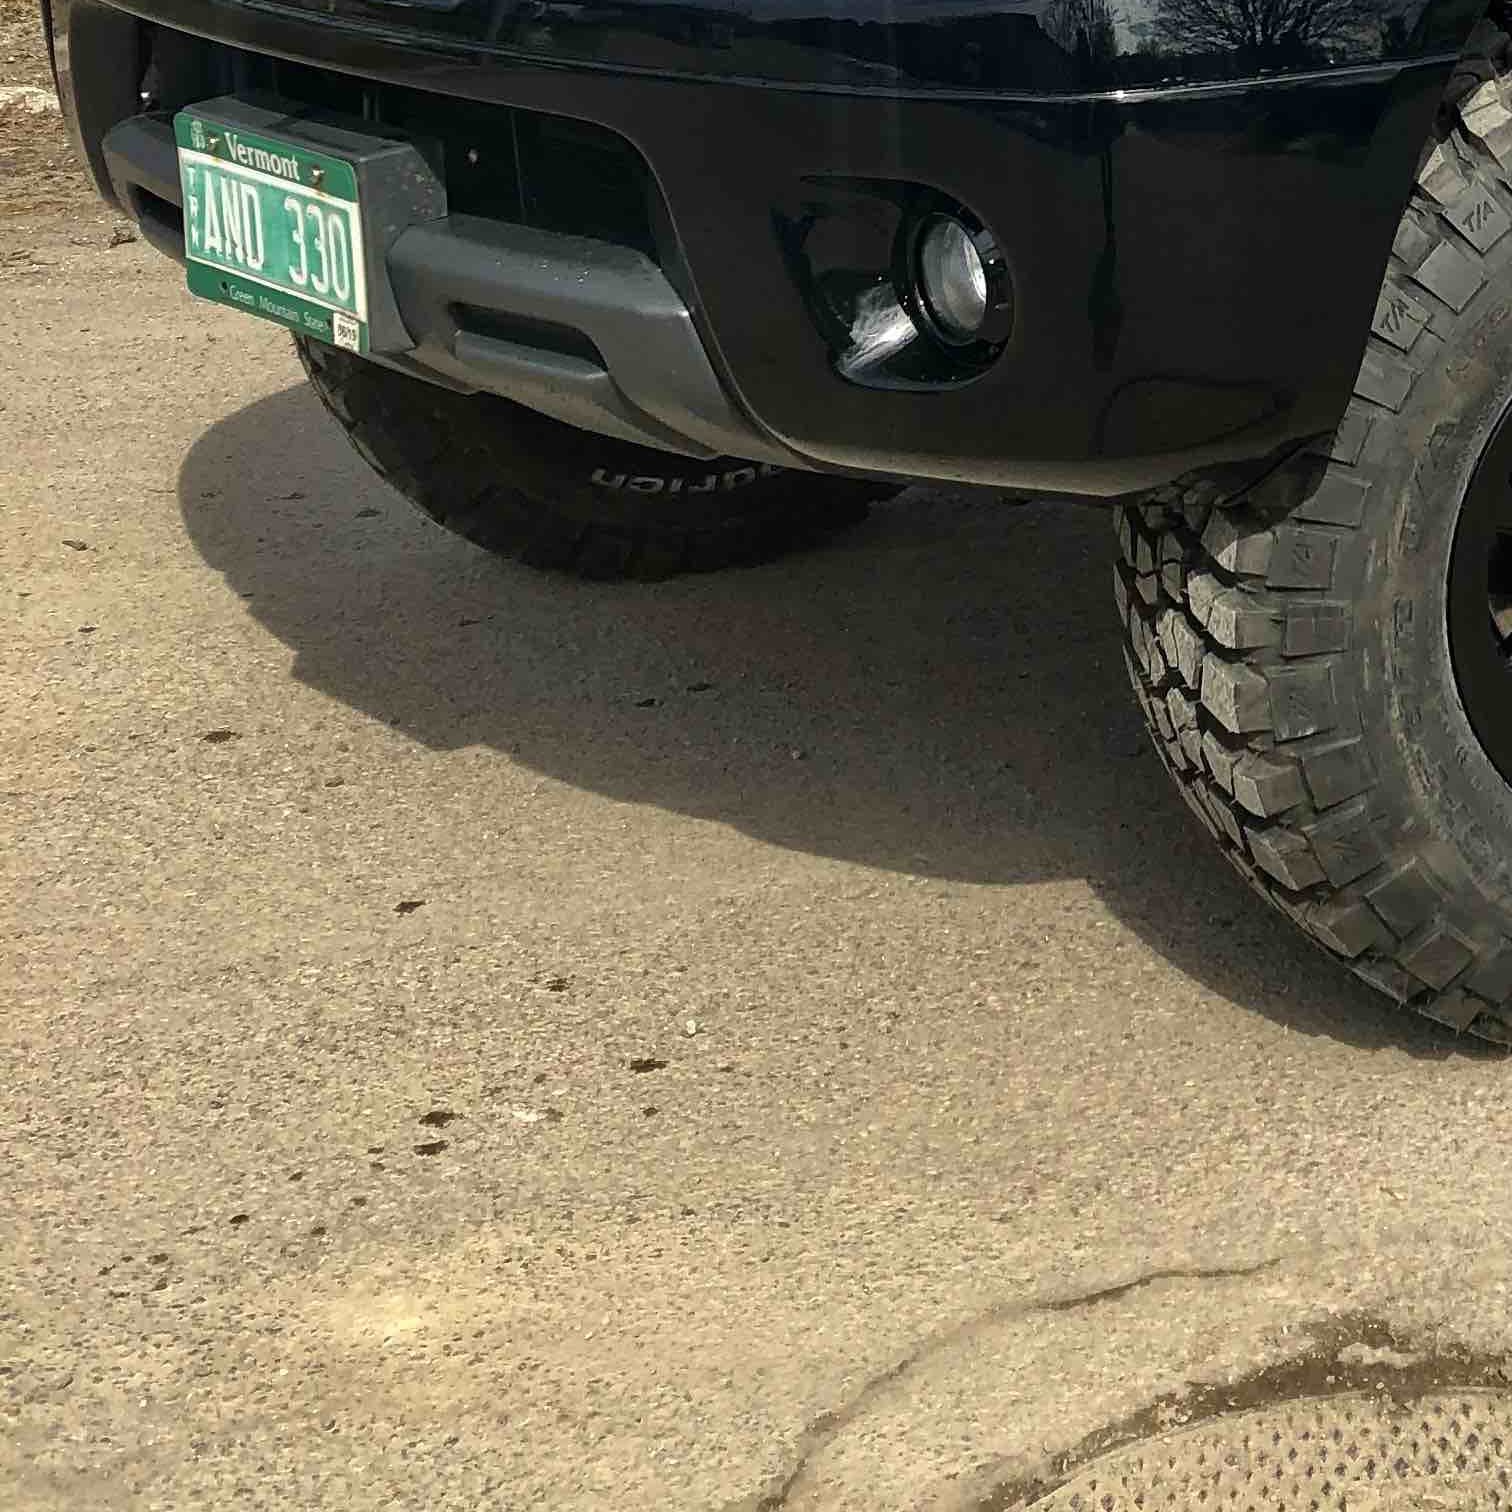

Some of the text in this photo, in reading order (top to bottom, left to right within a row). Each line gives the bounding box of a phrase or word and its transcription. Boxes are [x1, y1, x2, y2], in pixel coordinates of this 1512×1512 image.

[223, 131, 300, 180] Vermont
[203, 169, 349, 301] AND 330
